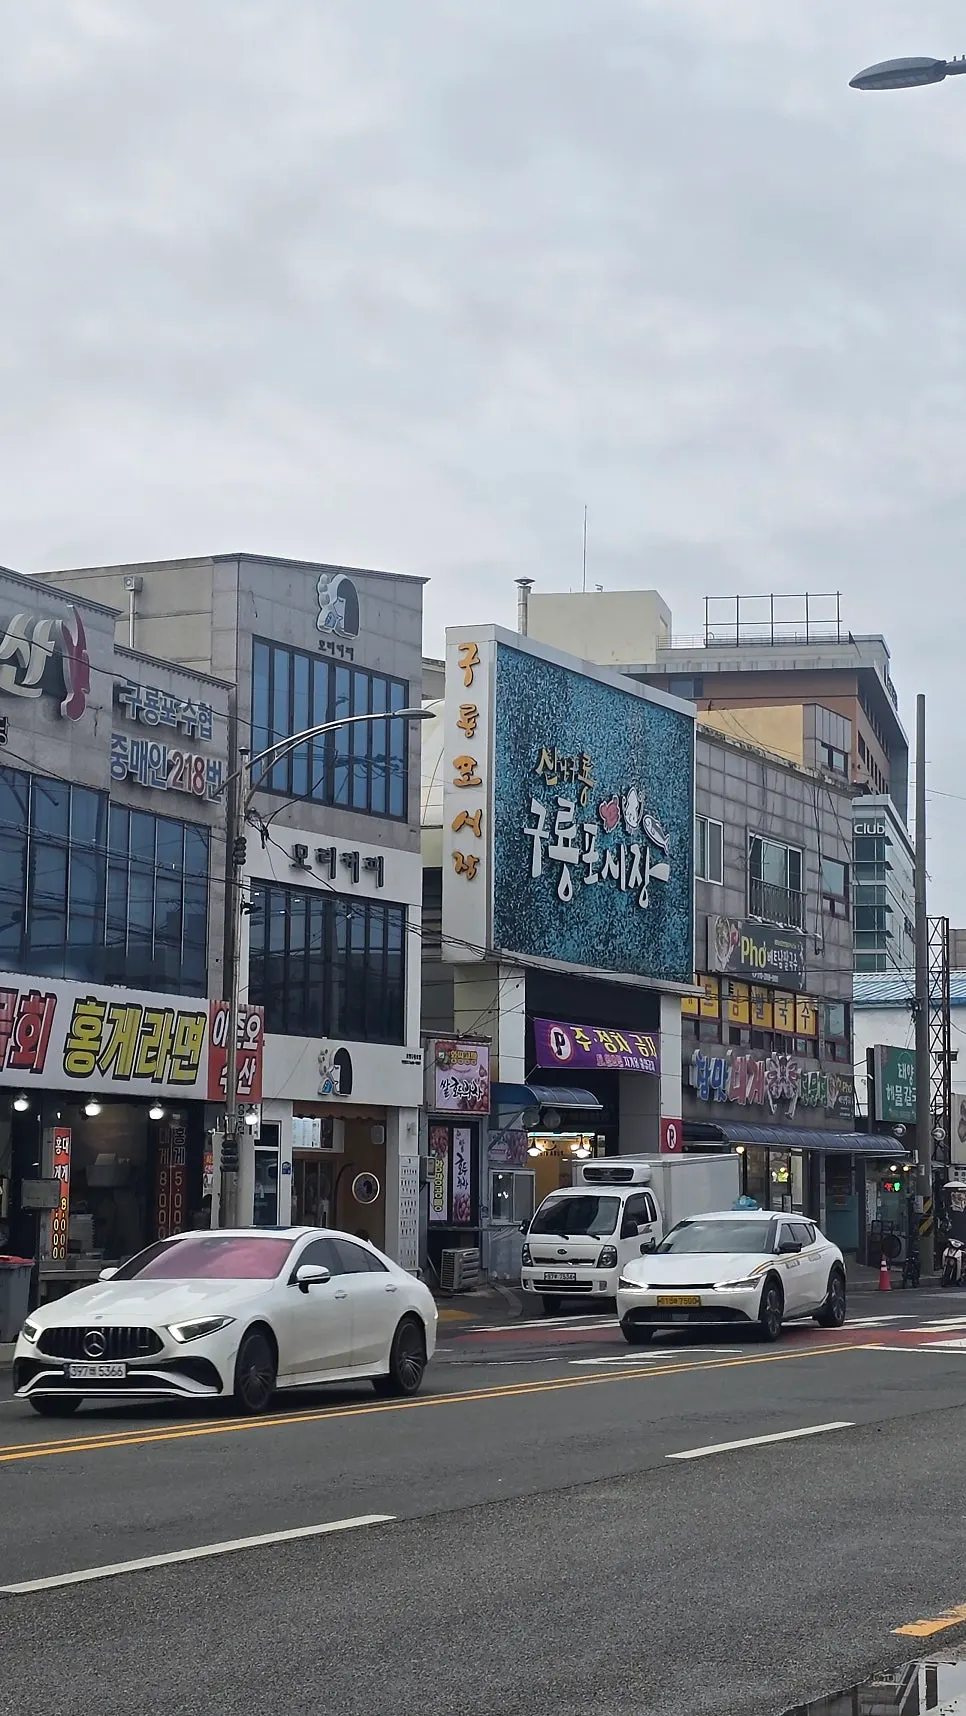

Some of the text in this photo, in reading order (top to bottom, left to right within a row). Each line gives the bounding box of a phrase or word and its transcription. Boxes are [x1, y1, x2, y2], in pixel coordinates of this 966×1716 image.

[119, 681, 214, 742] 구룡포수협
[452, 642, 483, 881] 구룡포시장
[854, 823, 885, 835] club
[289, 843, 384, 888] 모리커피
[65, 997, 206, 1084] 홍게라면
